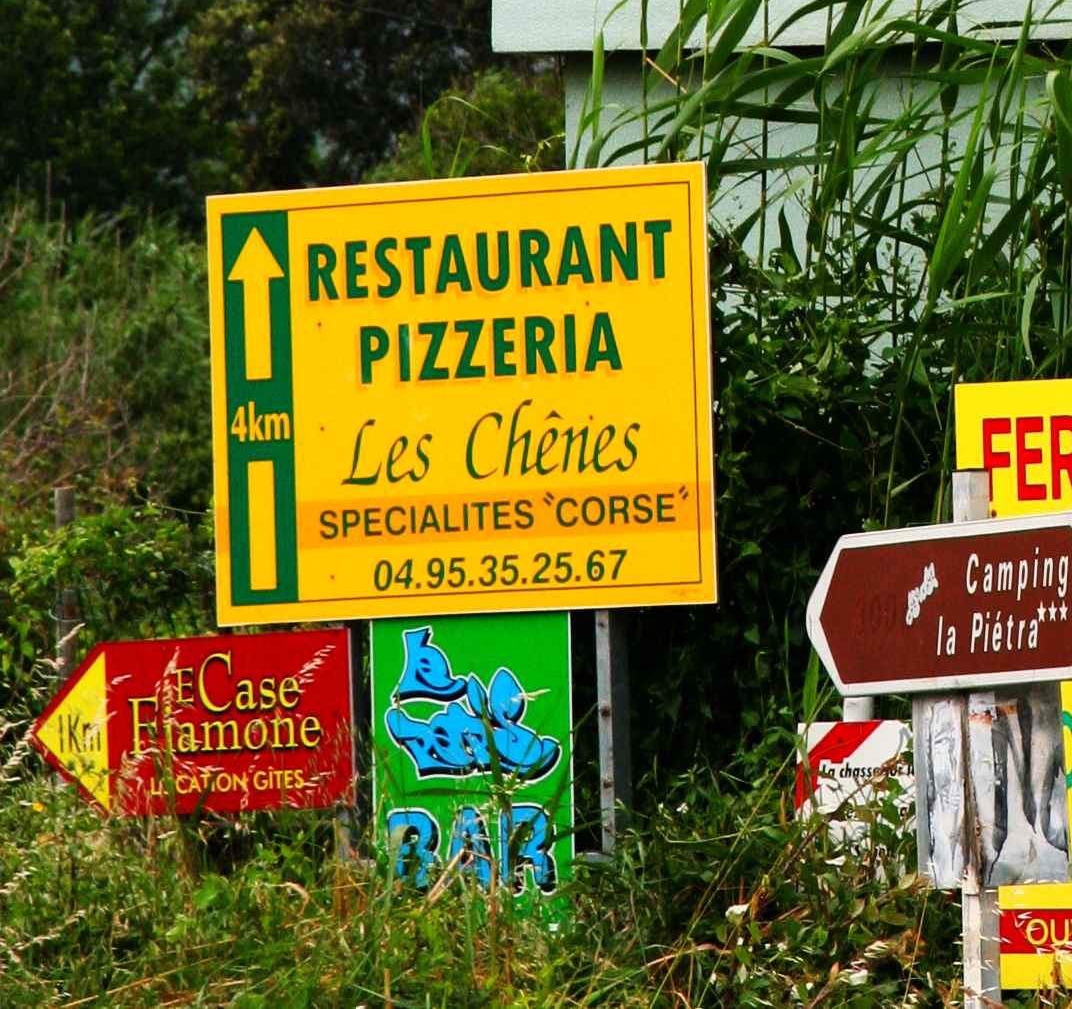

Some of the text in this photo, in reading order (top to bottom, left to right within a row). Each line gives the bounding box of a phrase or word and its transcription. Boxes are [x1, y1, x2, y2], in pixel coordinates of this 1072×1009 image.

[308, 219, 672, 301] RESTAURANT
[360, 312, 622, 384] PIZZERIA
[231, 401, 290, 443] 4km
[341, 399, 640, 485] Les Chênes
[320, 499, 534, 539] SPECIALITES
[374, 549, 627, 591] 04.95.35.25.67
[966, 547, 1068, 601] Camping
[937, 611, 1038, 656] la Piétra
[198, 650, 301, 713] Case
[150, 771, 248, 795] LCATON
[387, 804, 557, 894] BAR
